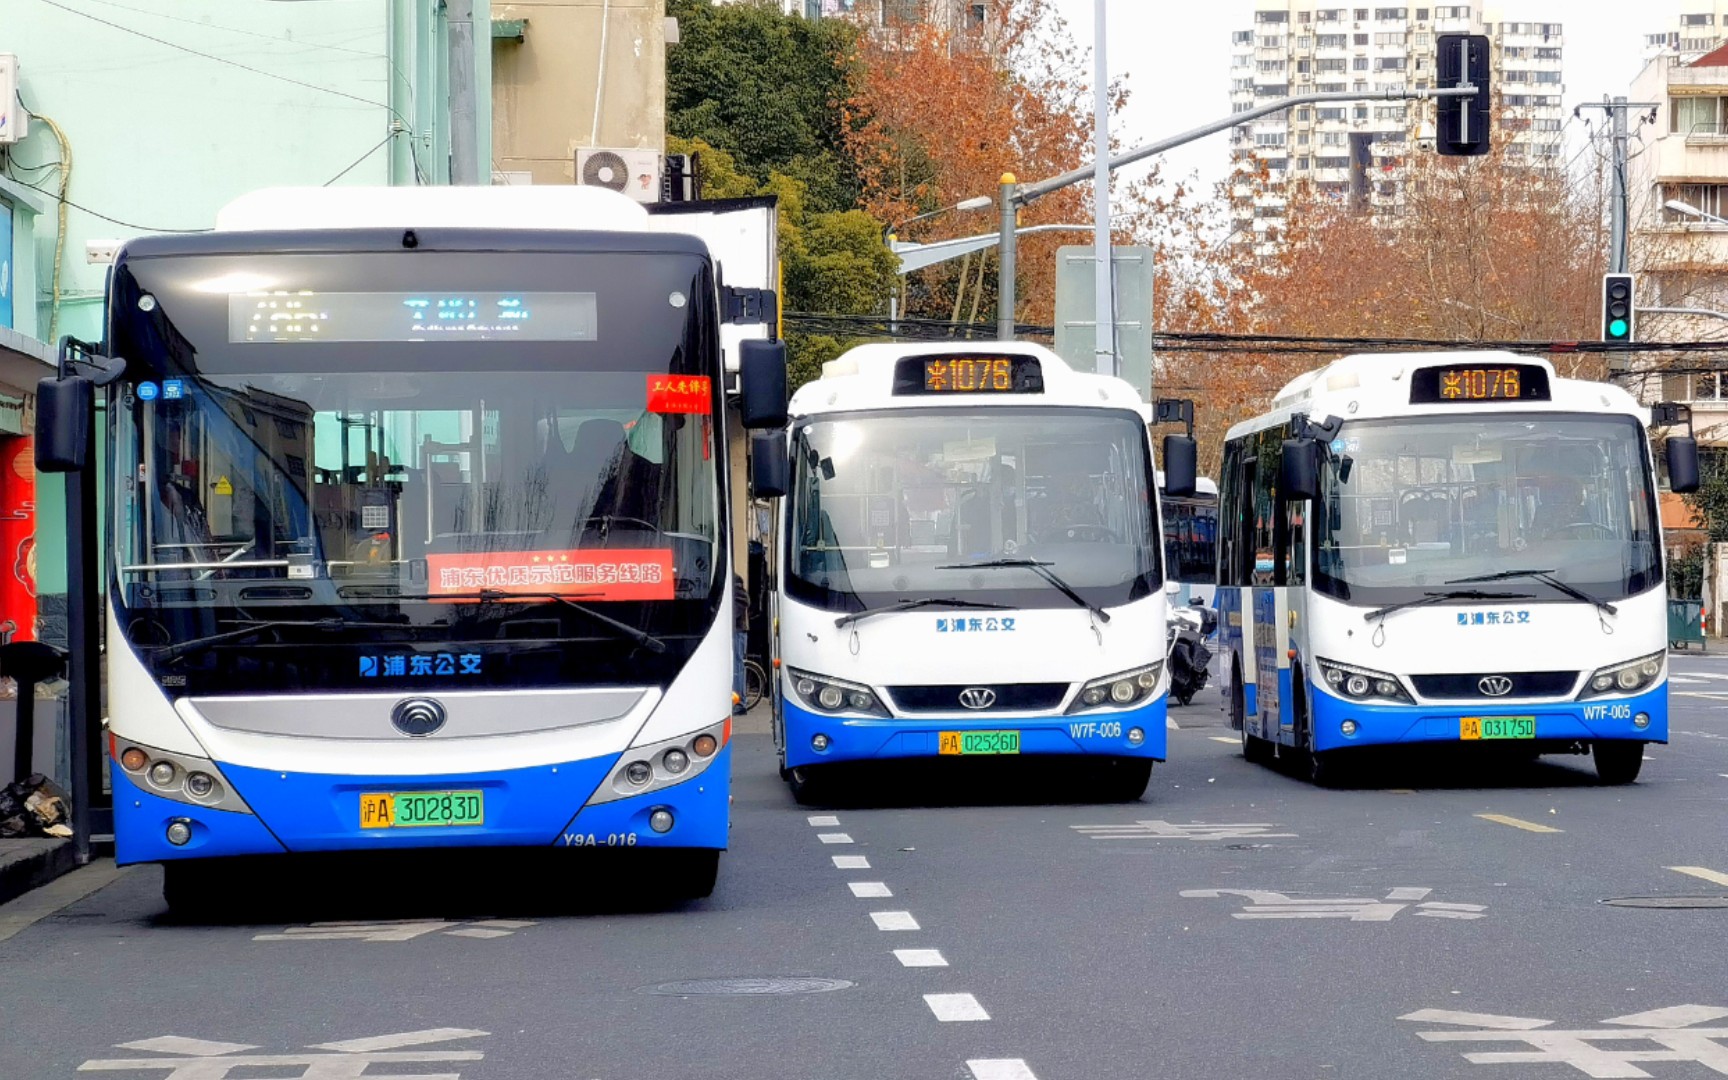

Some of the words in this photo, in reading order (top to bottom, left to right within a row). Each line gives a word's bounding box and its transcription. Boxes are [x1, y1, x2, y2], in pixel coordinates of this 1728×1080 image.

[950, 359, 1009, 390] 1076
[1463, 370, 1518, 398] 1076
[440, 564, 662, 588] 浦东优质示范服务线路
[951, 617, 1016, 632] 浦东公交
[1471, 611, 1530, 625] 浦东公交
[383, 653, 482, 676] 浦东公交
[1583, 705, 1631, 721] W7F-005
[1070, 722, 1121, 739] W7F-006
[563, 833, 637, 847] Y9A-016
